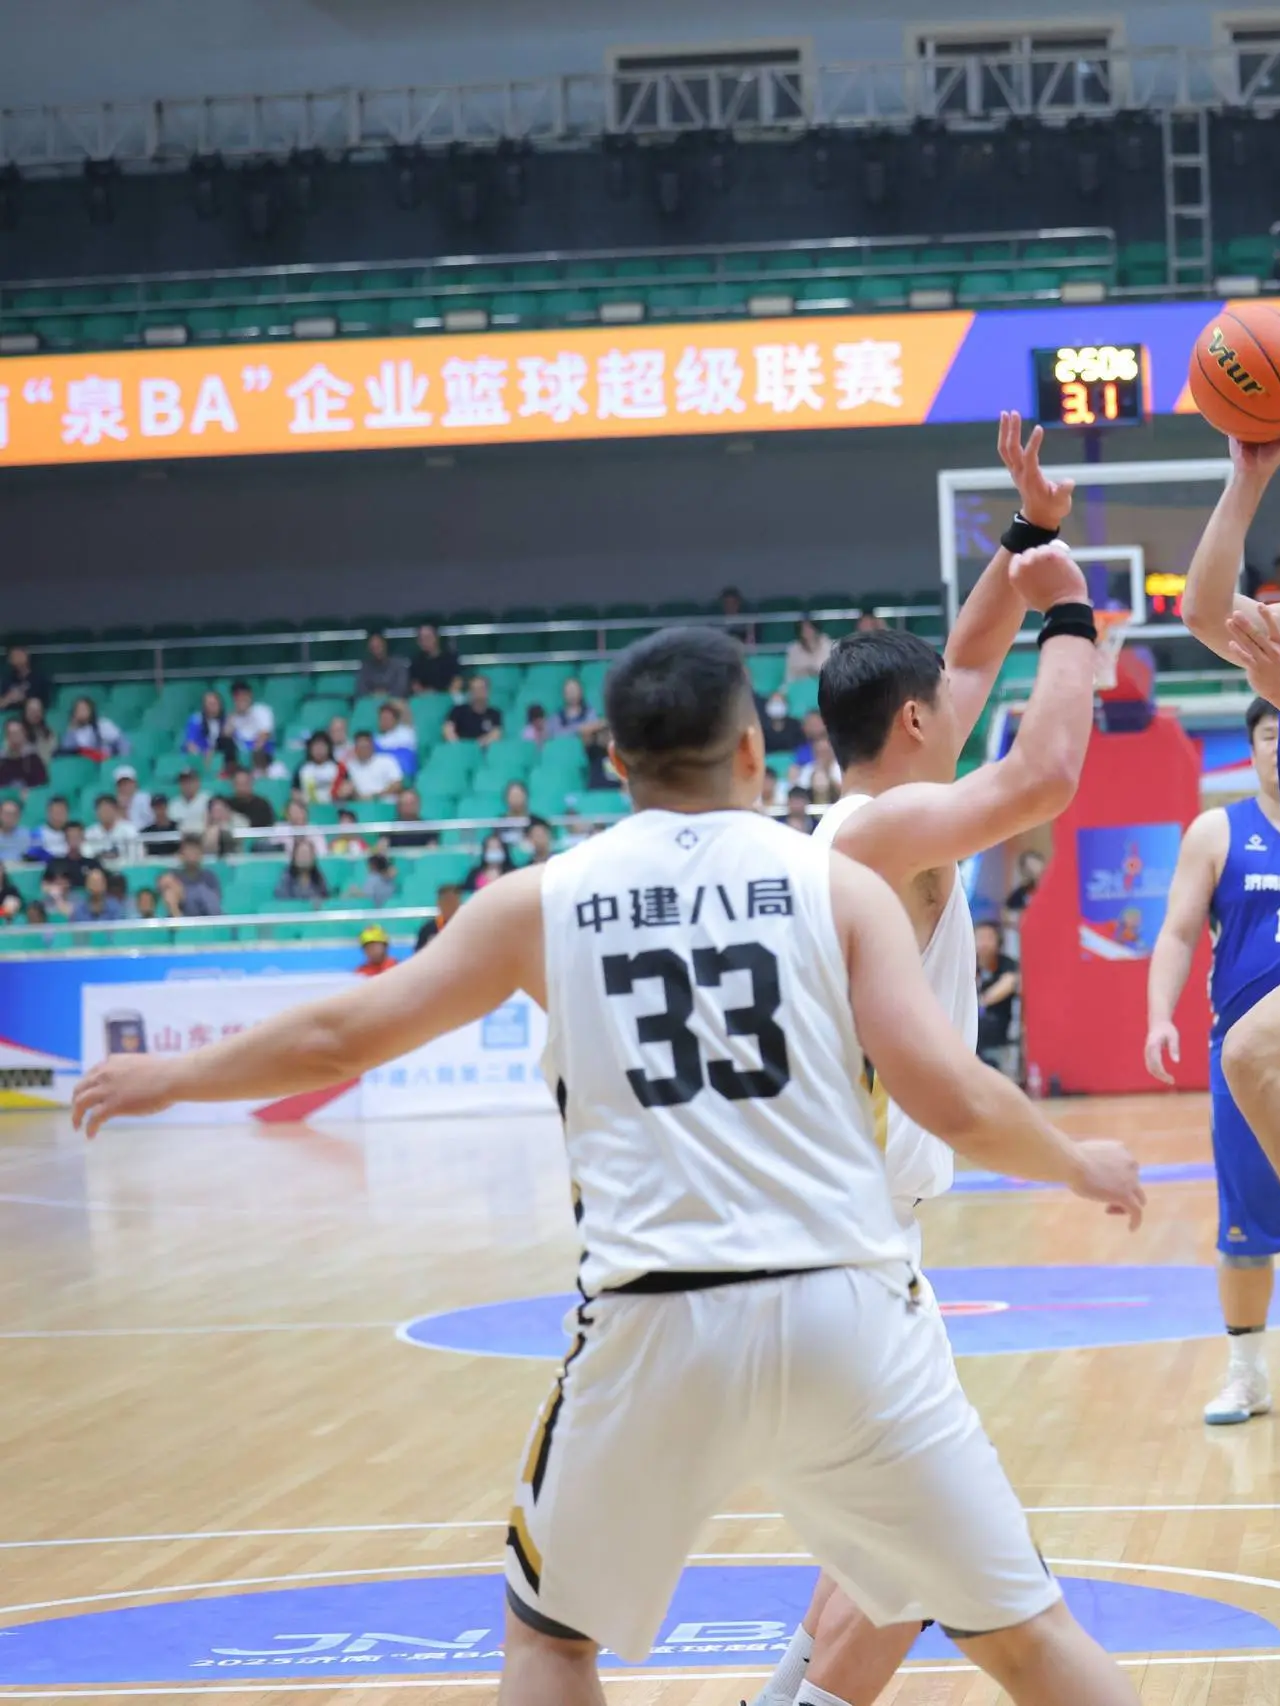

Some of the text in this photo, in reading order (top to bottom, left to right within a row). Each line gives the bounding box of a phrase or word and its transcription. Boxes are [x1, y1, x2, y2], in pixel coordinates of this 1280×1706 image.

[0, 339, 904, 449] “泉BA”企业篮球超级联赛
[576, 877, 796, 934] 中建八局
[602, 941, 791, 1109] 33
